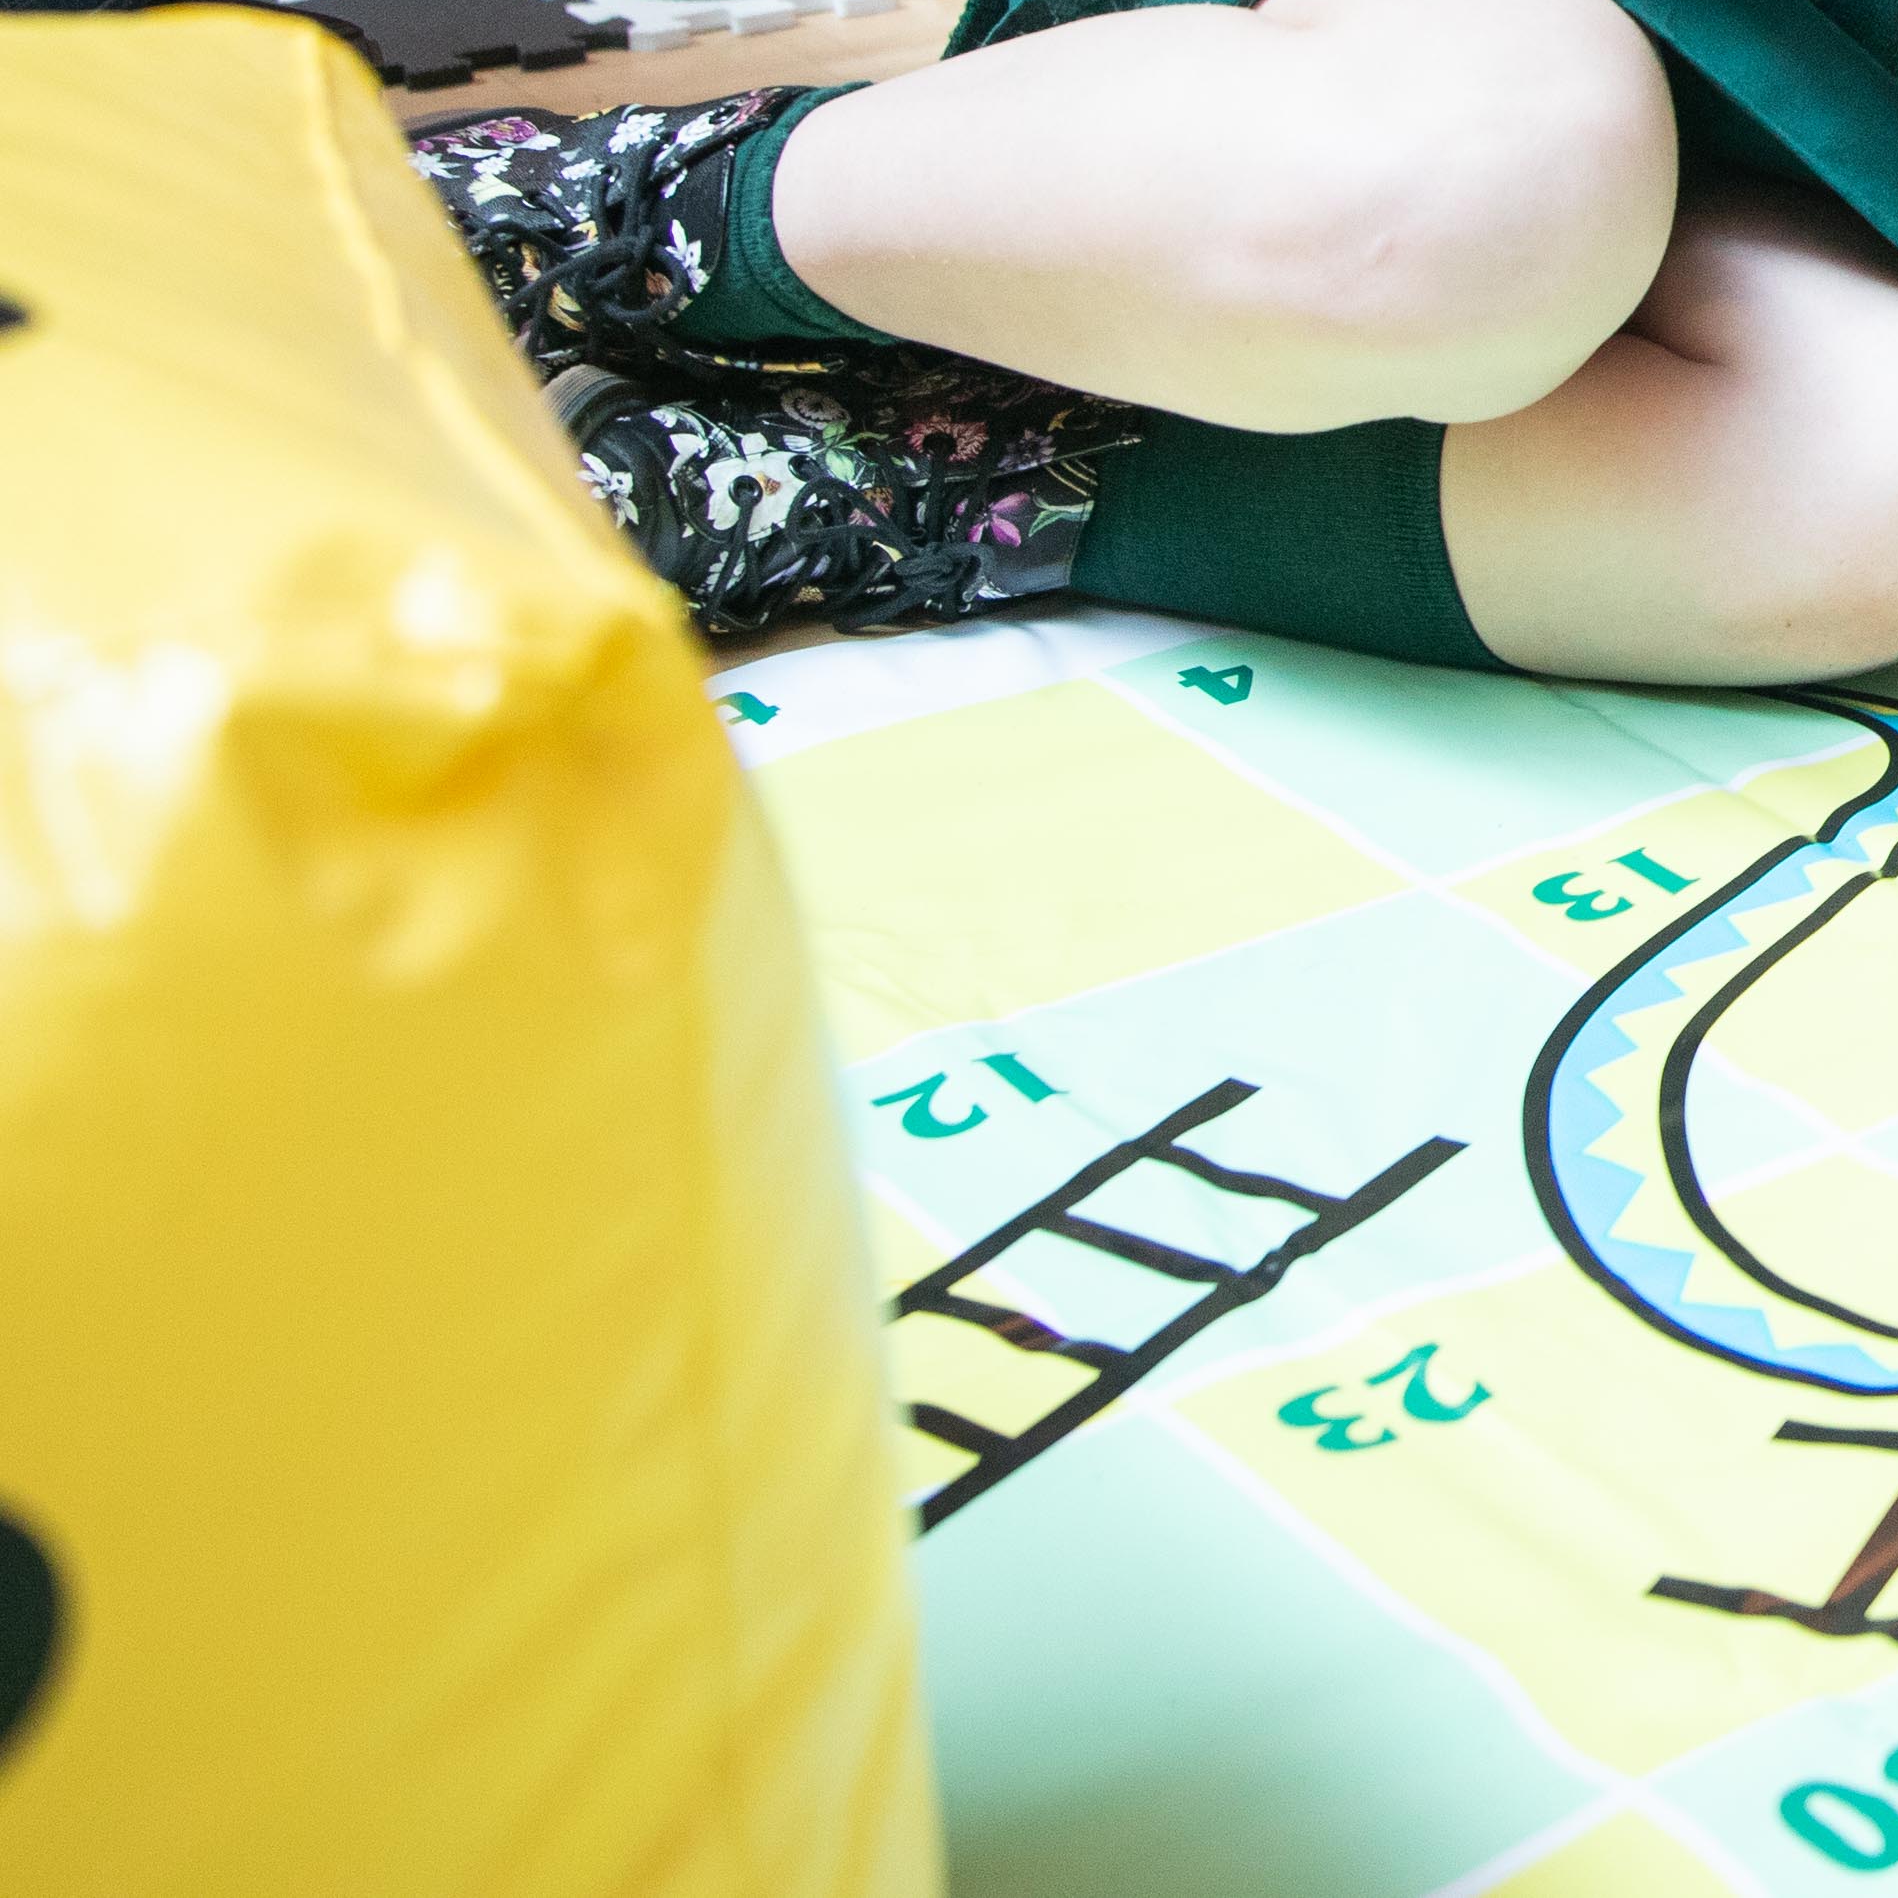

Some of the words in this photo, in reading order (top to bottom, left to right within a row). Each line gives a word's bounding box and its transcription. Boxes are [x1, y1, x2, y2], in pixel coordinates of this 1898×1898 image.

[1176, 661, 1256, 707] 4
[1530, 845, 1702, 924] 13
[868, 1050, 1070, 1141] 12
[1276, 1343, 1493, 1453] 23
